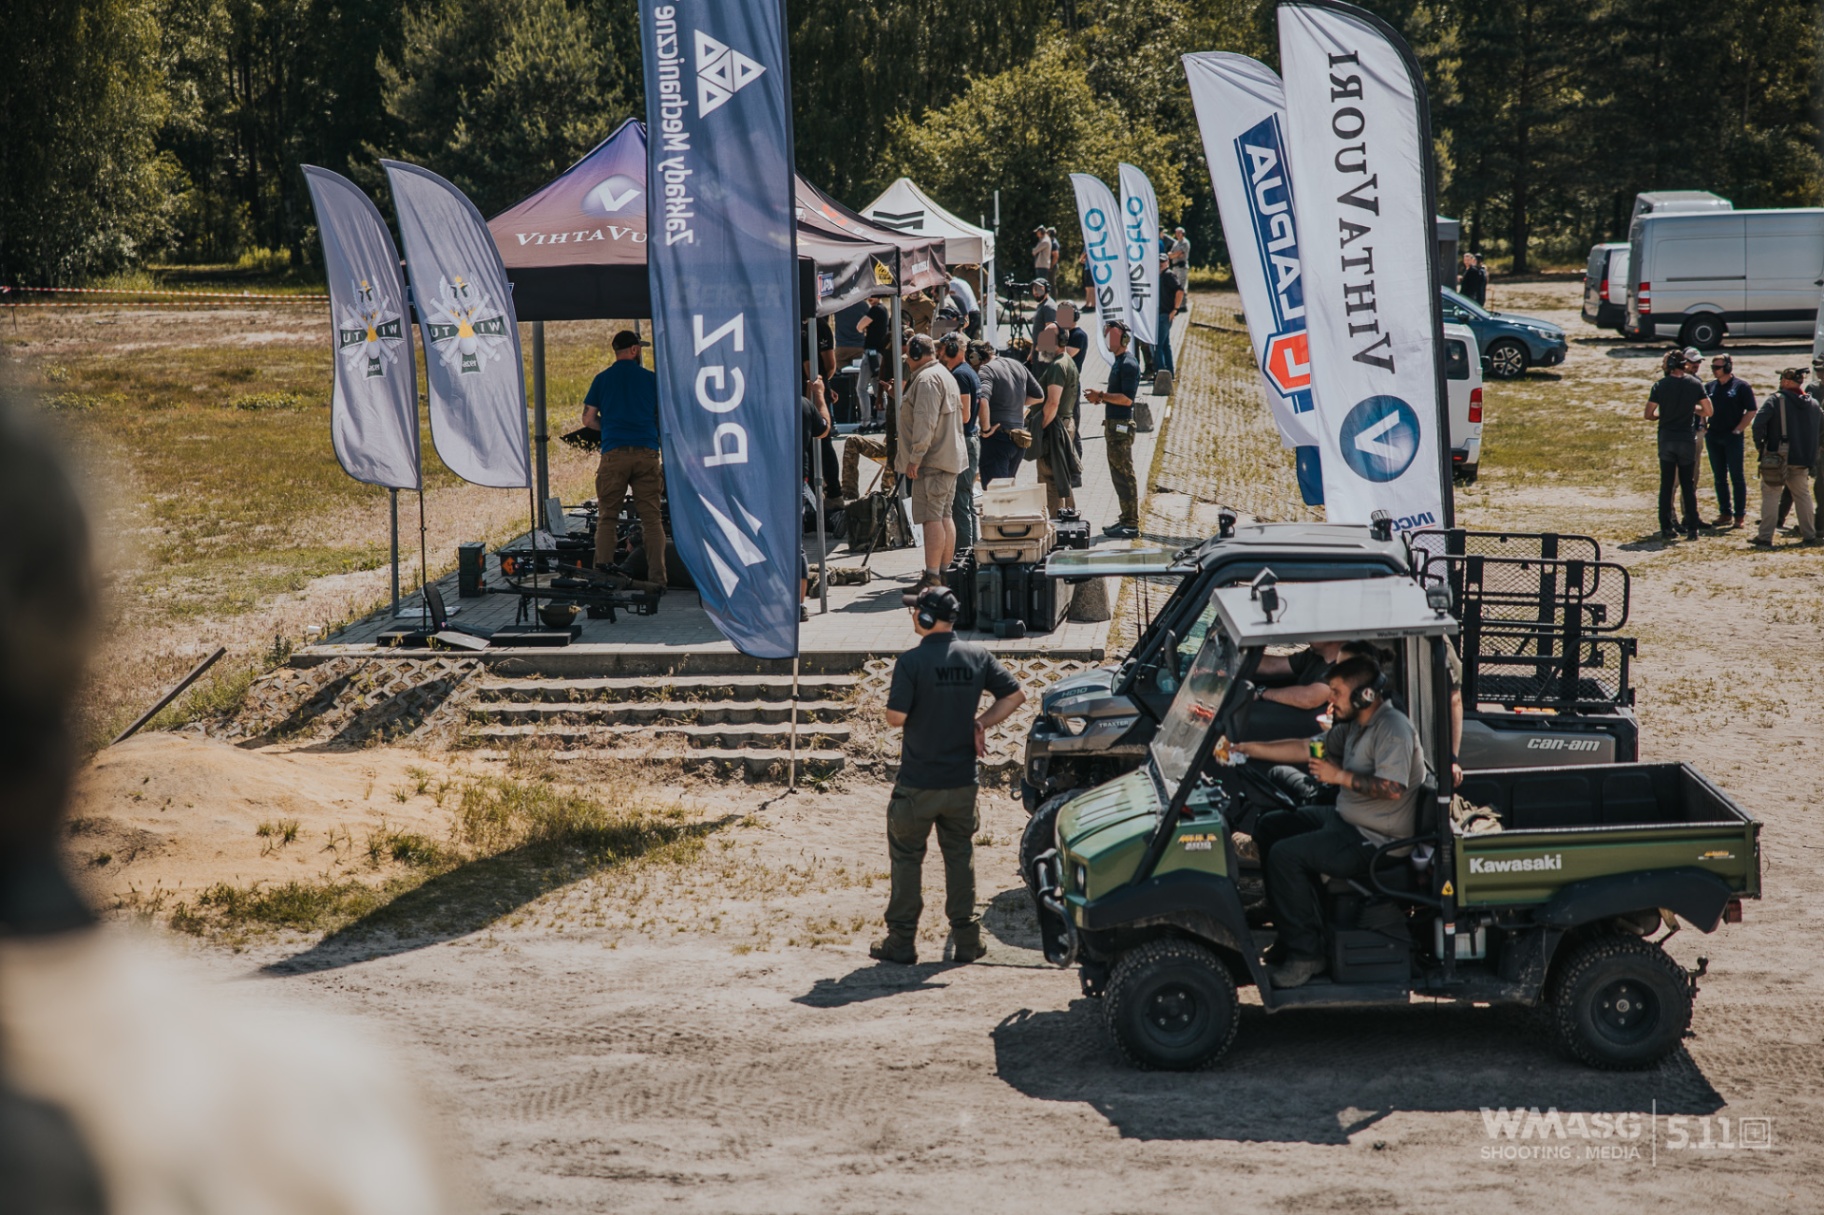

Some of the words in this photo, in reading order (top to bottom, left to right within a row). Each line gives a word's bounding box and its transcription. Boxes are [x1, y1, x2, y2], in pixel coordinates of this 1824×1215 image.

[935, 667, 973, 681] WITU
[1061, 687, 1088, 698] HD10
[1099, 720, 1129, 728] TRAXTER
[1527, 738, 1601, 752] can-am
[1469, 854, 1562, 874] Kawasaki
